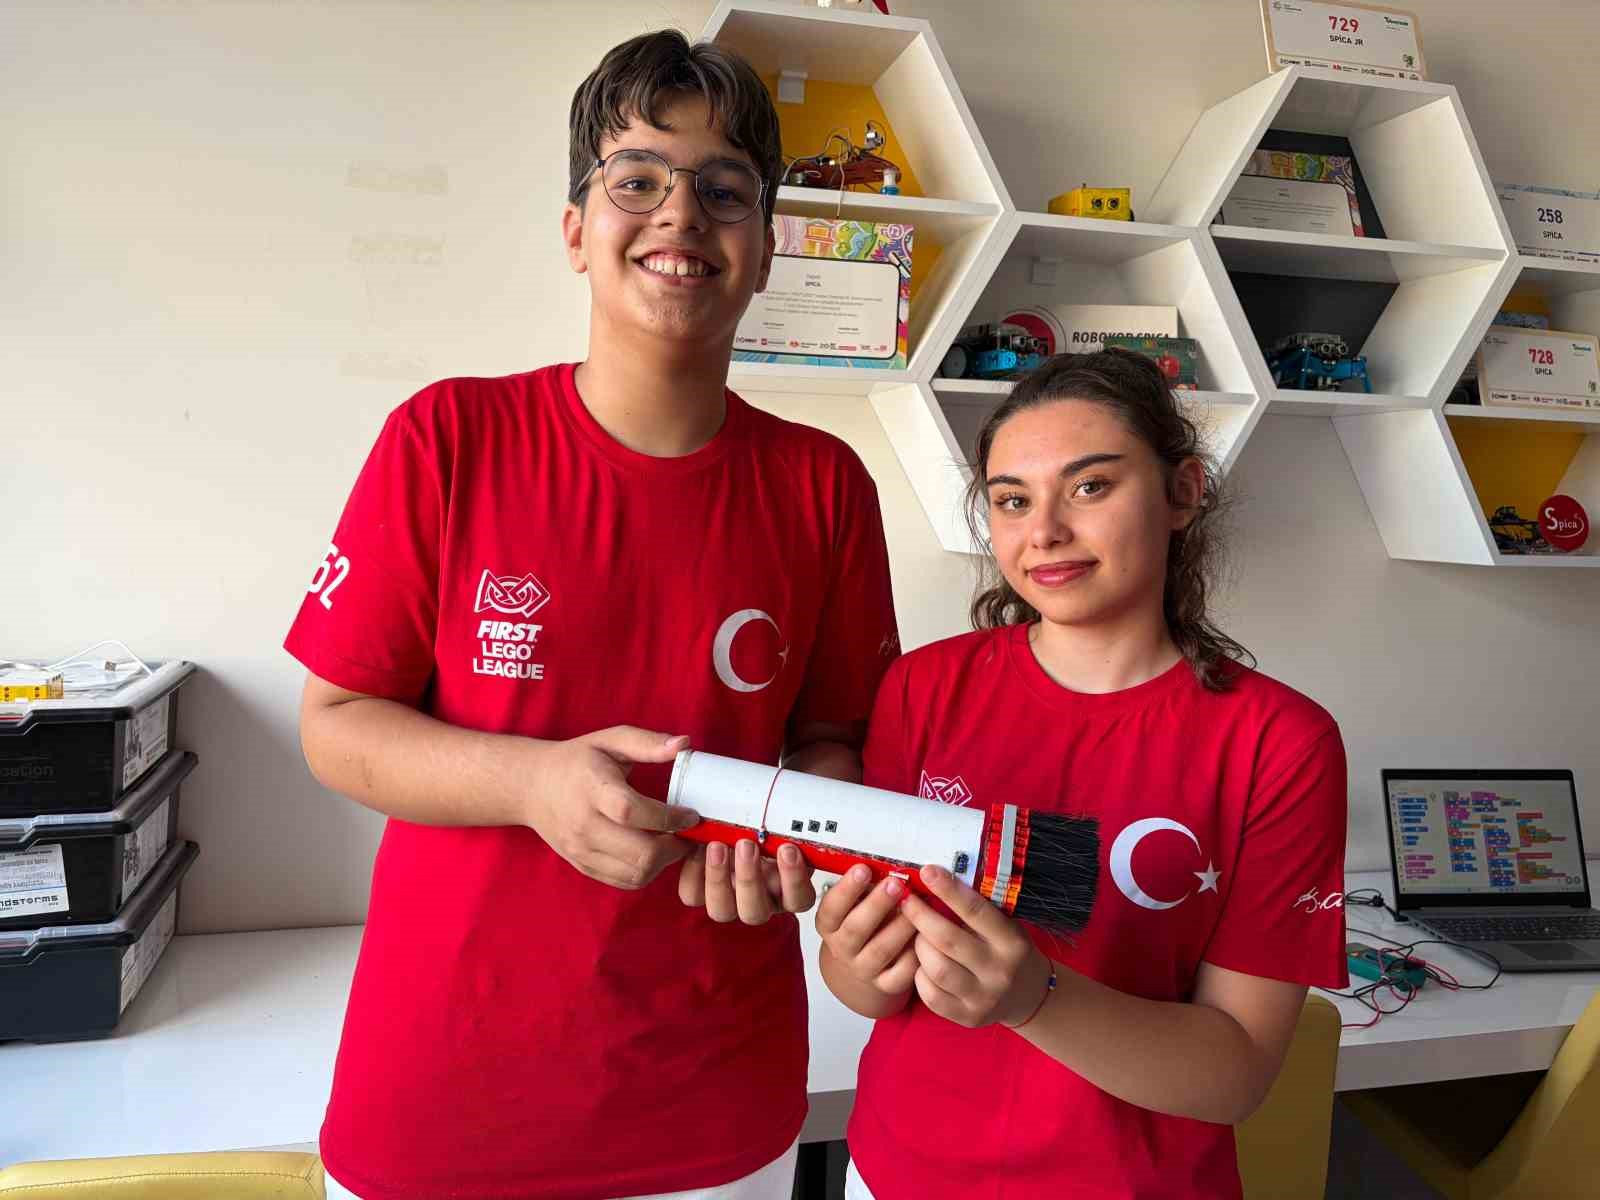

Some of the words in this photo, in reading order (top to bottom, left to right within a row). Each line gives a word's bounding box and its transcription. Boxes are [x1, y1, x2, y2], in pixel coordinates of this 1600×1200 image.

[1328, 15, 1359, 33] 729
[1537, 208, 1563, 224] 258
[1528, 348, 1554, 365] 728
[1545, 507, 1577, 531] Spica
[477, 620, 543, 642] FIRST
[482, 641, 531, 660] LEGO
[473, 657, 544, 680] LEAGUE
